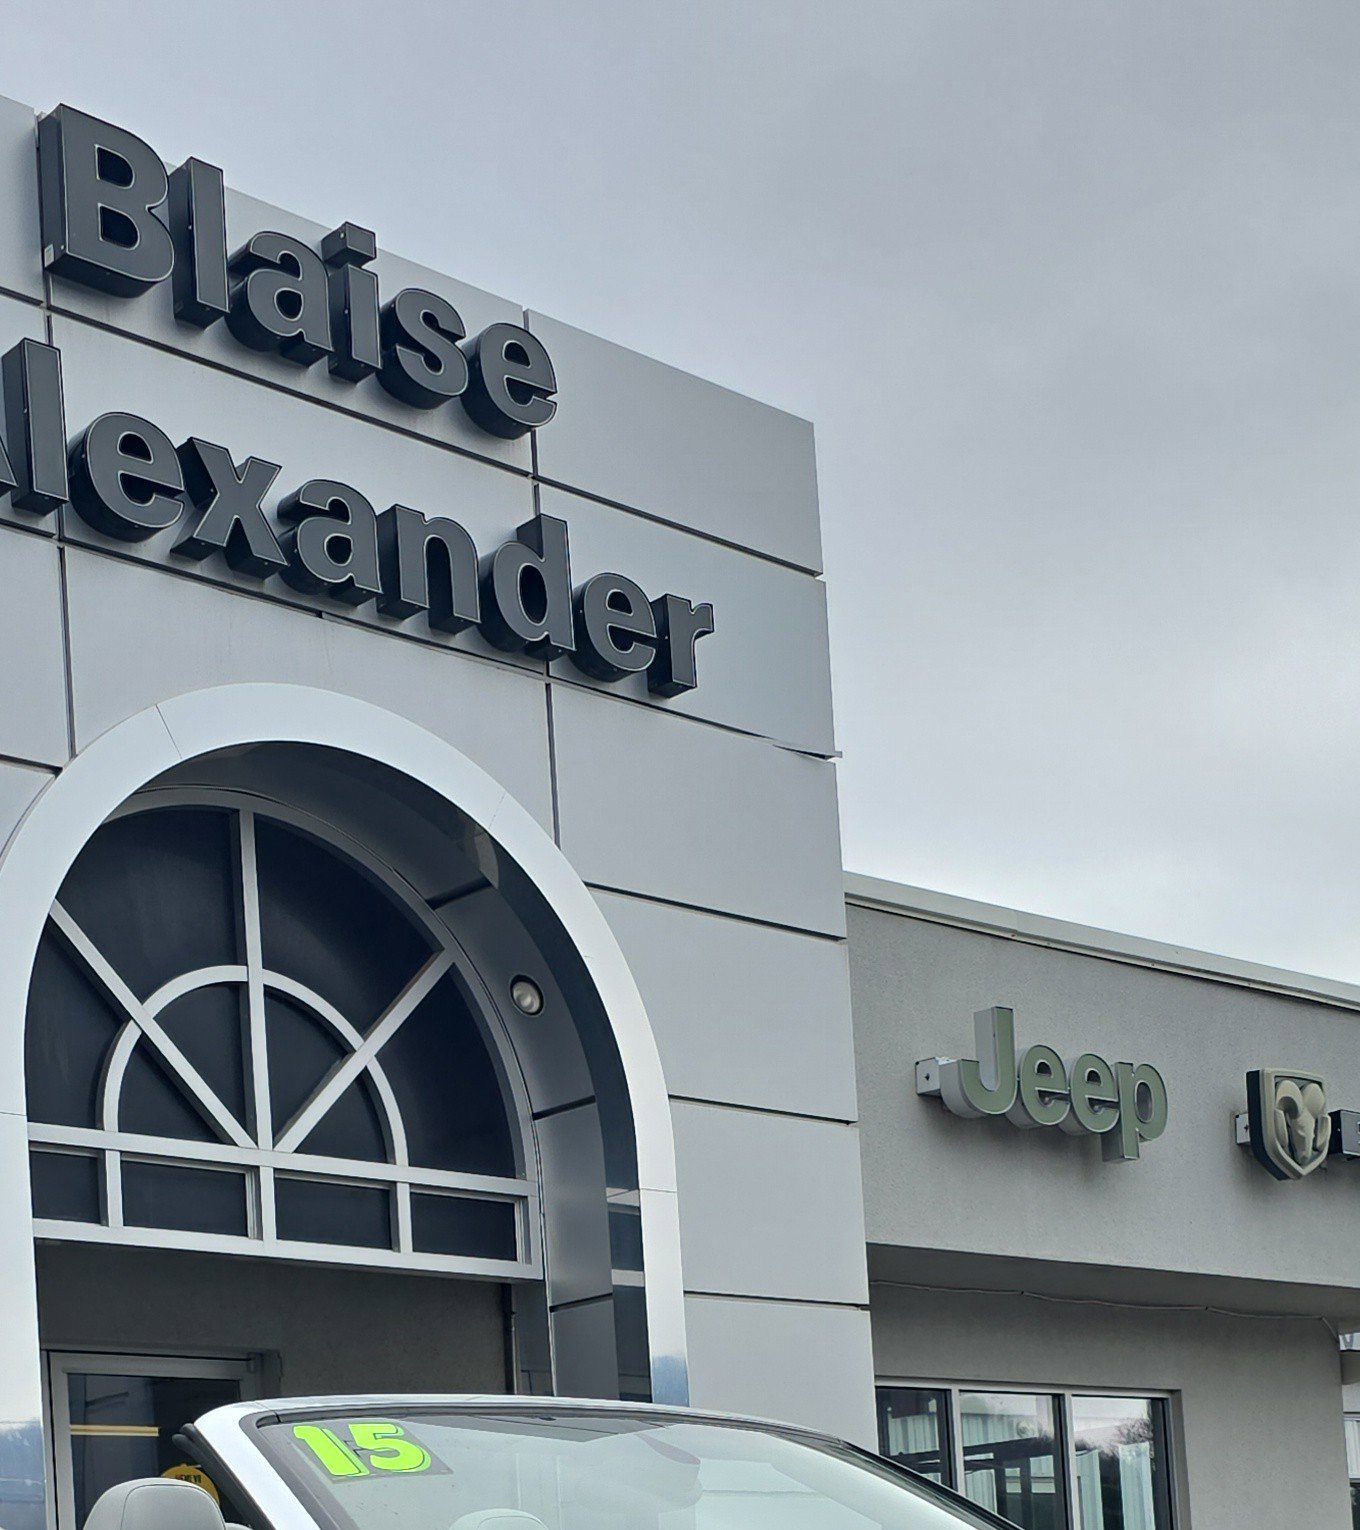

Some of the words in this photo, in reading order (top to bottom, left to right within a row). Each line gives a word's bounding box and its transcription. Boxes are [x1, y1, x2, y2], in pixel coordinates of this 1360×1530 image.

[38, 103, 559, 439] Blaise
[940, 1006, 1168, 1161] Jeep
[293, 1422, 431, 1477] 15
